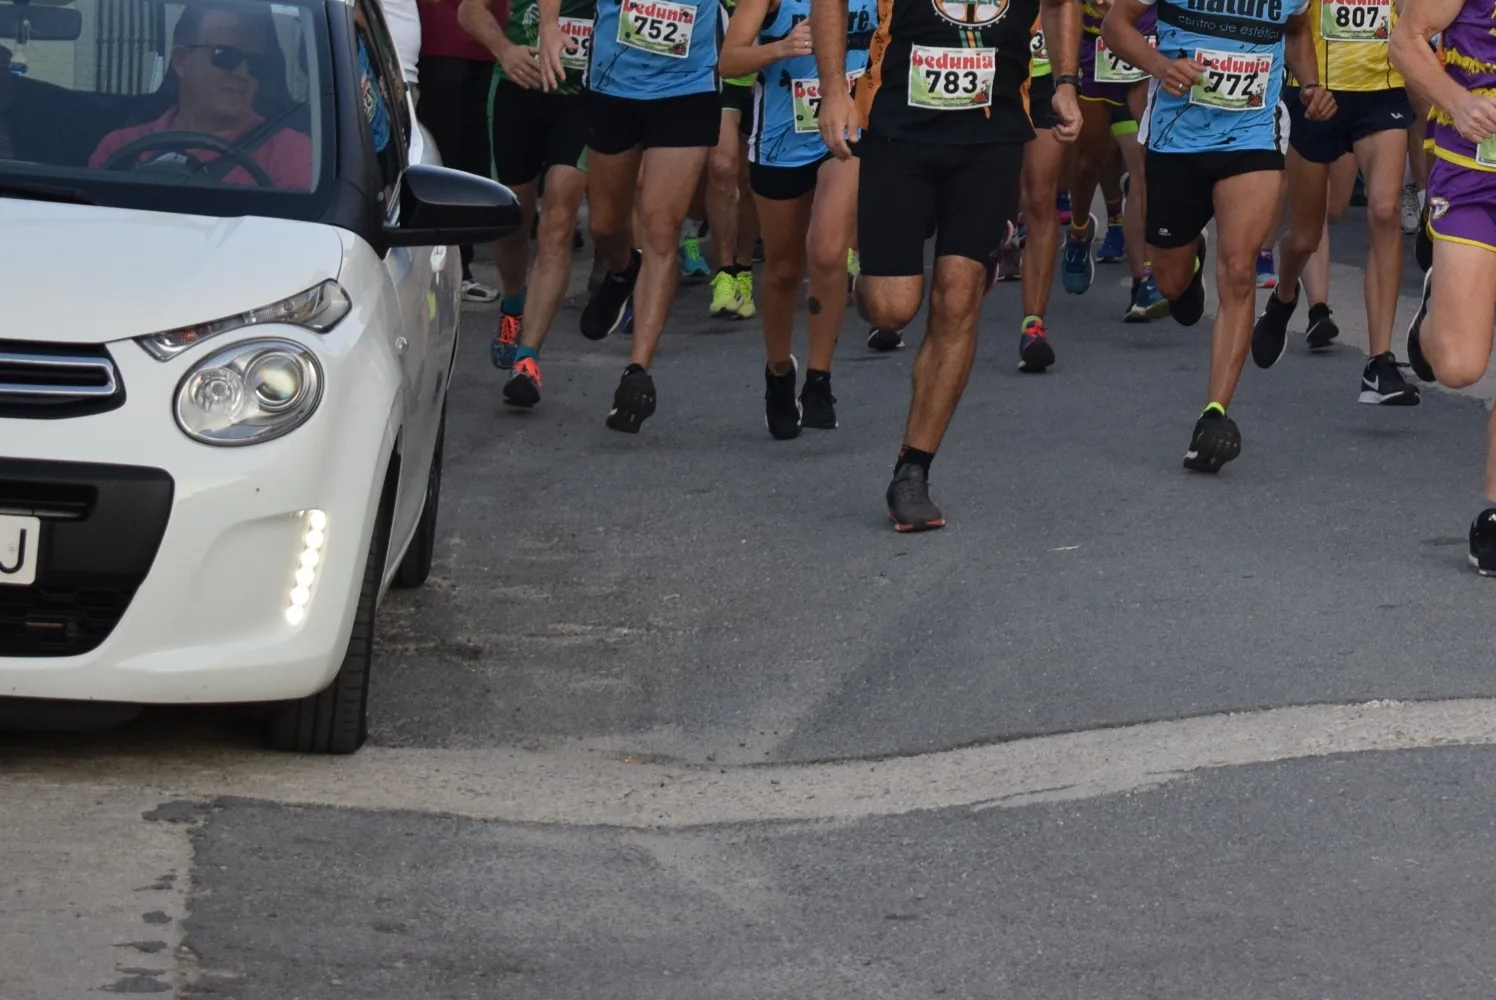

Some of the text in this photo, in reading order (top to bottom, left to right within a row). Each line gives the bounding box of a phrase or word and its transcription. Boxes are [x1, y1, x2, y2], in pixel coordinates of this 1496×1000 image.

[633, 15, 679, 43] 752
[1177, 14, 1280, 39] centro de estética
[1336, 6, 1379, 28] 807
[911, 50, 993, 70] bedunia
[1196, 52, 1270, 74] bedunia
[925, 69, 978, 94] 783
[1209, 71, 1255, 96] 772
